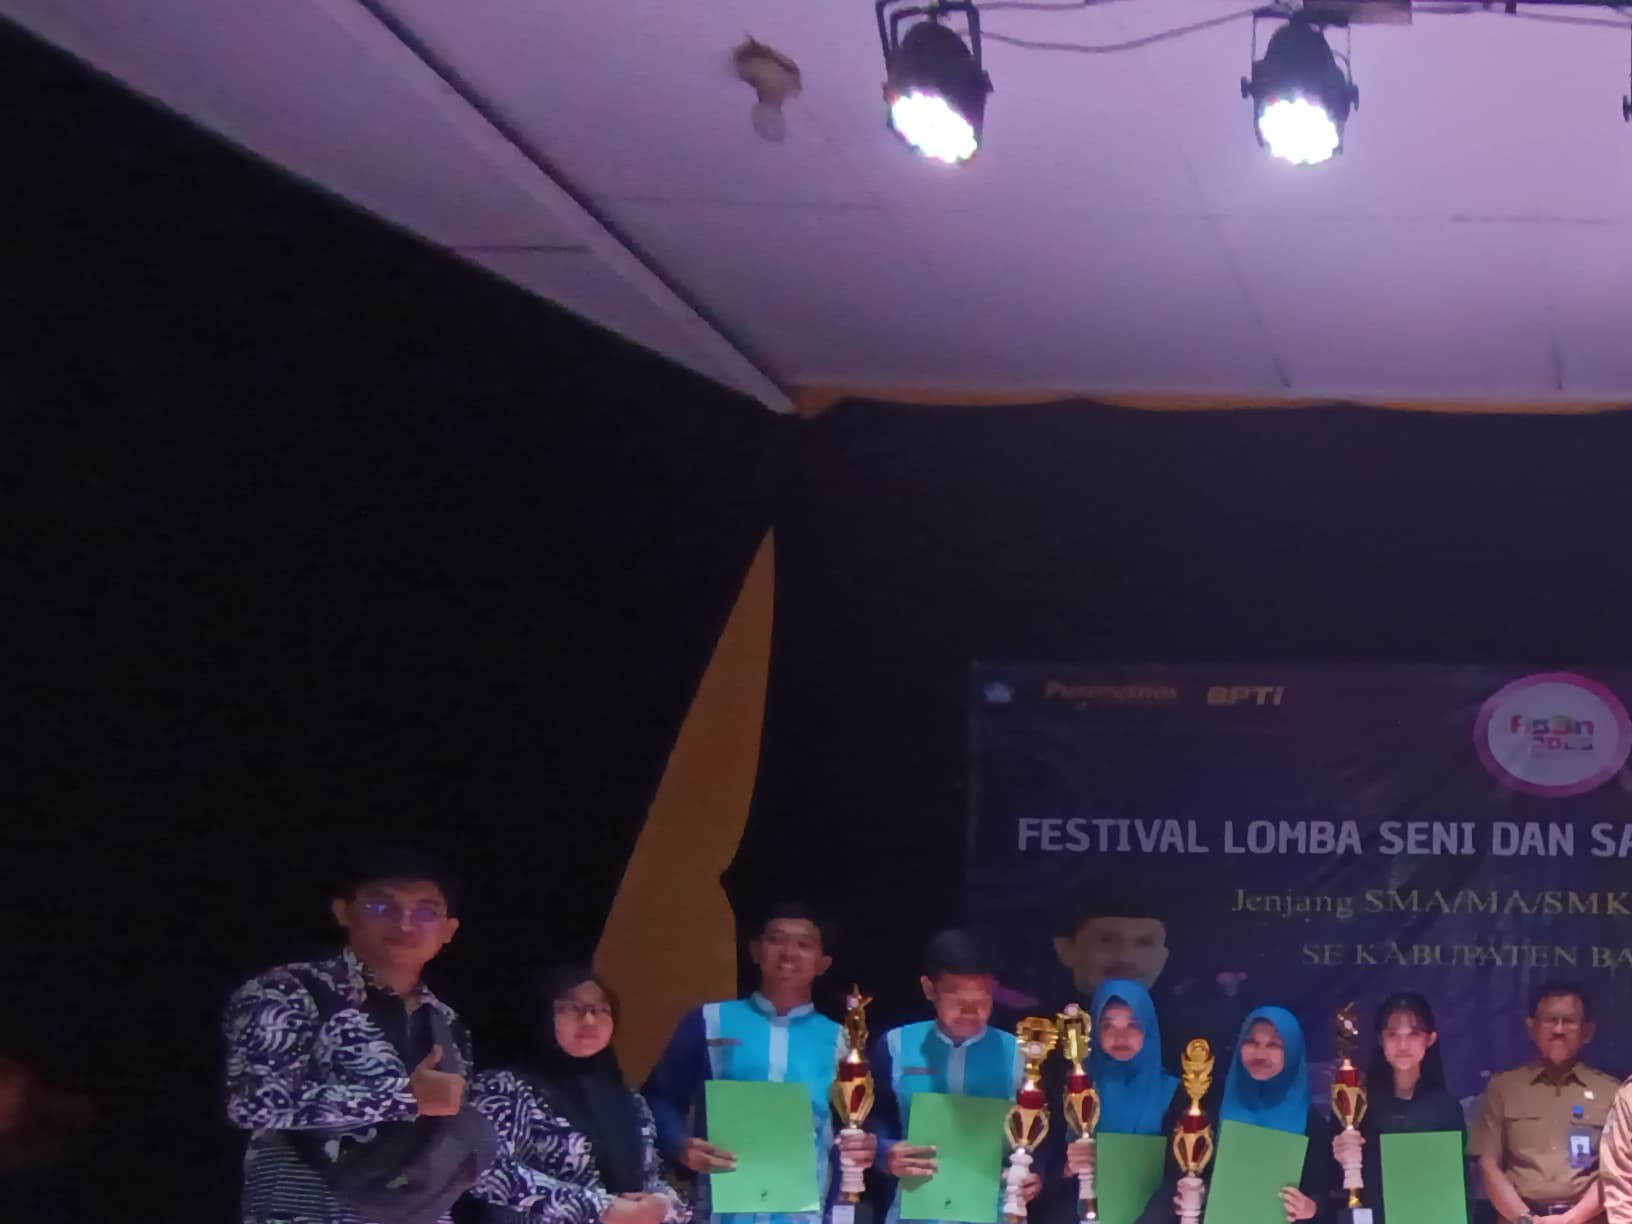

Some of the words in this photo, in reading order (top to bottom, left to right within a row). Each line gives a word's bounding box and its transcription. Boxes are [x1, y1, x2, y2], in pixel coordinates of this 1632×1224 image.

[1018, 817, 1209, 854] FESTIVAL
[1223, 820, 1362, 856] LOMBA
[1378, 821, 1475, 857] SENI
[1491, 822, 1574, 857] DAN
[1231, 887, 1354, 920] Jenjang
[1301, 943, 1344, 966] SE
[1356, 941, 1580, 968] KABUPATEN
